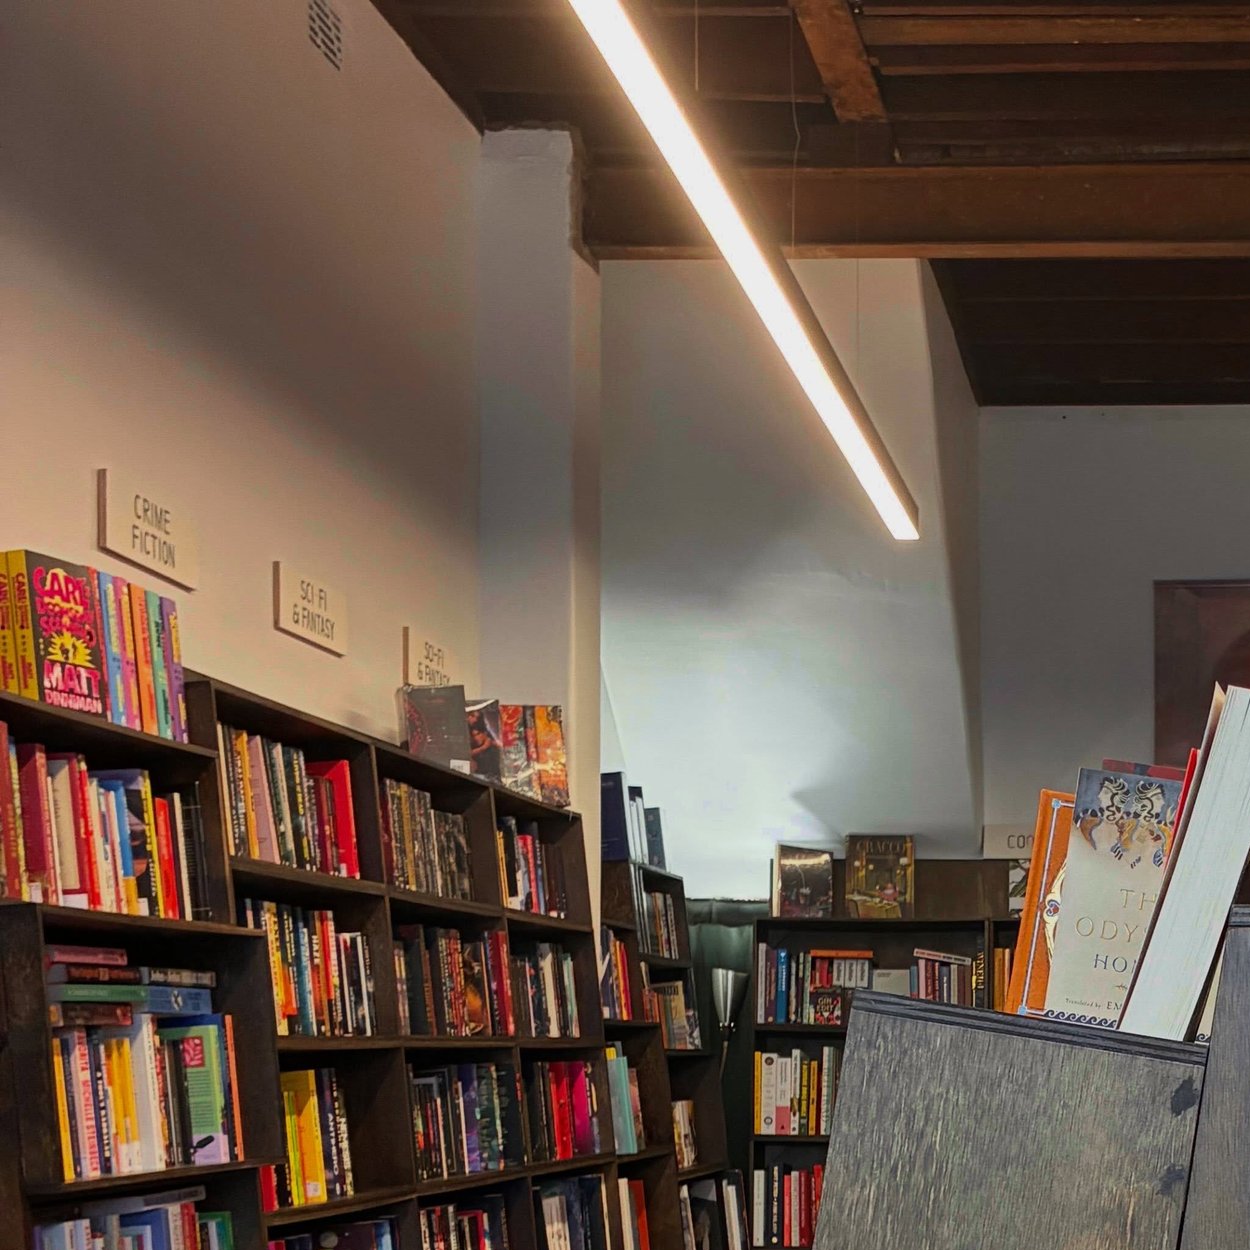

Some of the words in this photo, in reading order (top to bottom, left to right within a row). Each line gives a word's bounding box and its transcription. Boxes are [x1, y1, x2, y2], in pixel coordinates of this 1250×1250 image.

[134, 494, 171, 535] CRIME
[131, 524, 176, 568] FICTION
[302, 607, 335, 641] FANTASY
[44, 659, 100, 697] MATT
[1075, 916, 1148, 943] ODY
[86, 1125, 99, 1172] STEINBECK
